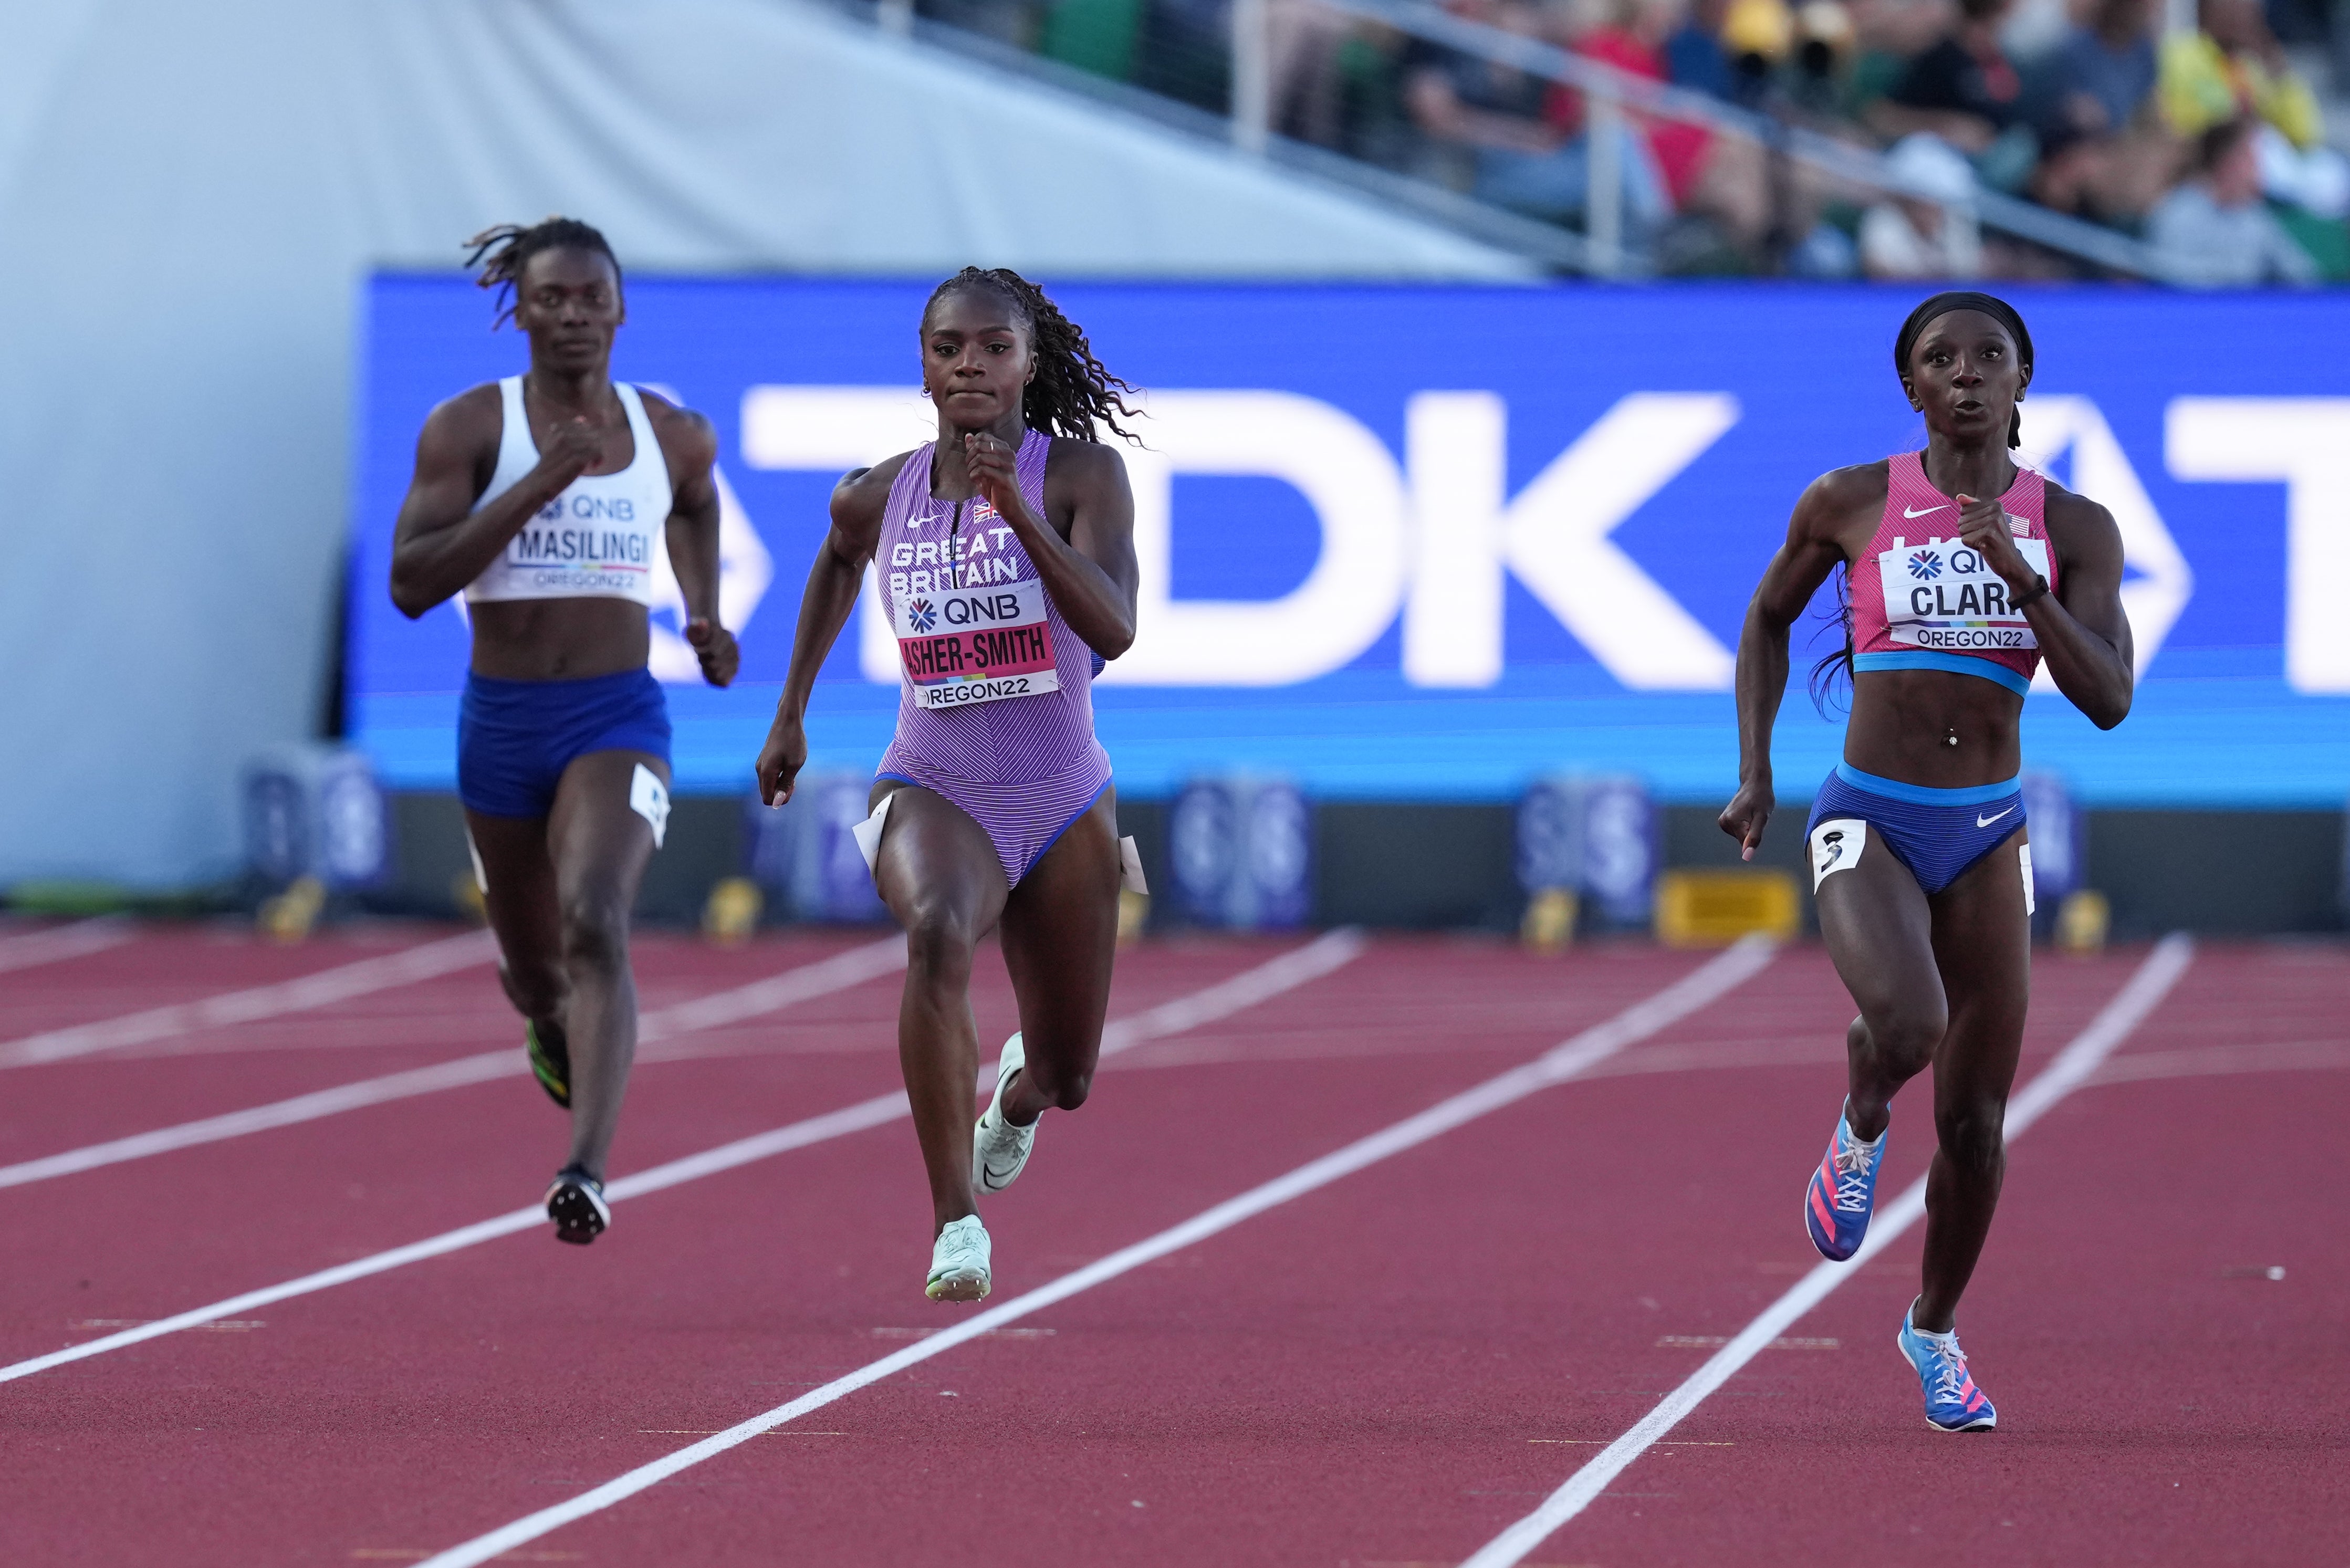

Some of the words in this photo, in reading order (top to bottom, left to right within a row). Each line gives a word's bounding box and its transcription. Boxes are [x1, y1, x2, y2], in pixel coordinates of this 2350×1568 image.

[572, 495, 635, 520] QNB
[519, 529, 649, 562] MASILINGI
[892, 527, 1015, 567] GREAT
[890, 557, 1018, 595] BRITAIN
[944, 594, 1020, 625] QNB
[1910, 583, 2024, 616] CLAR
[904, 626, 1046, 675] ASHER-SMITH
[1917, 629, 2023, 647] OREGON22
[925, 678, 1030, 704] REGON22
